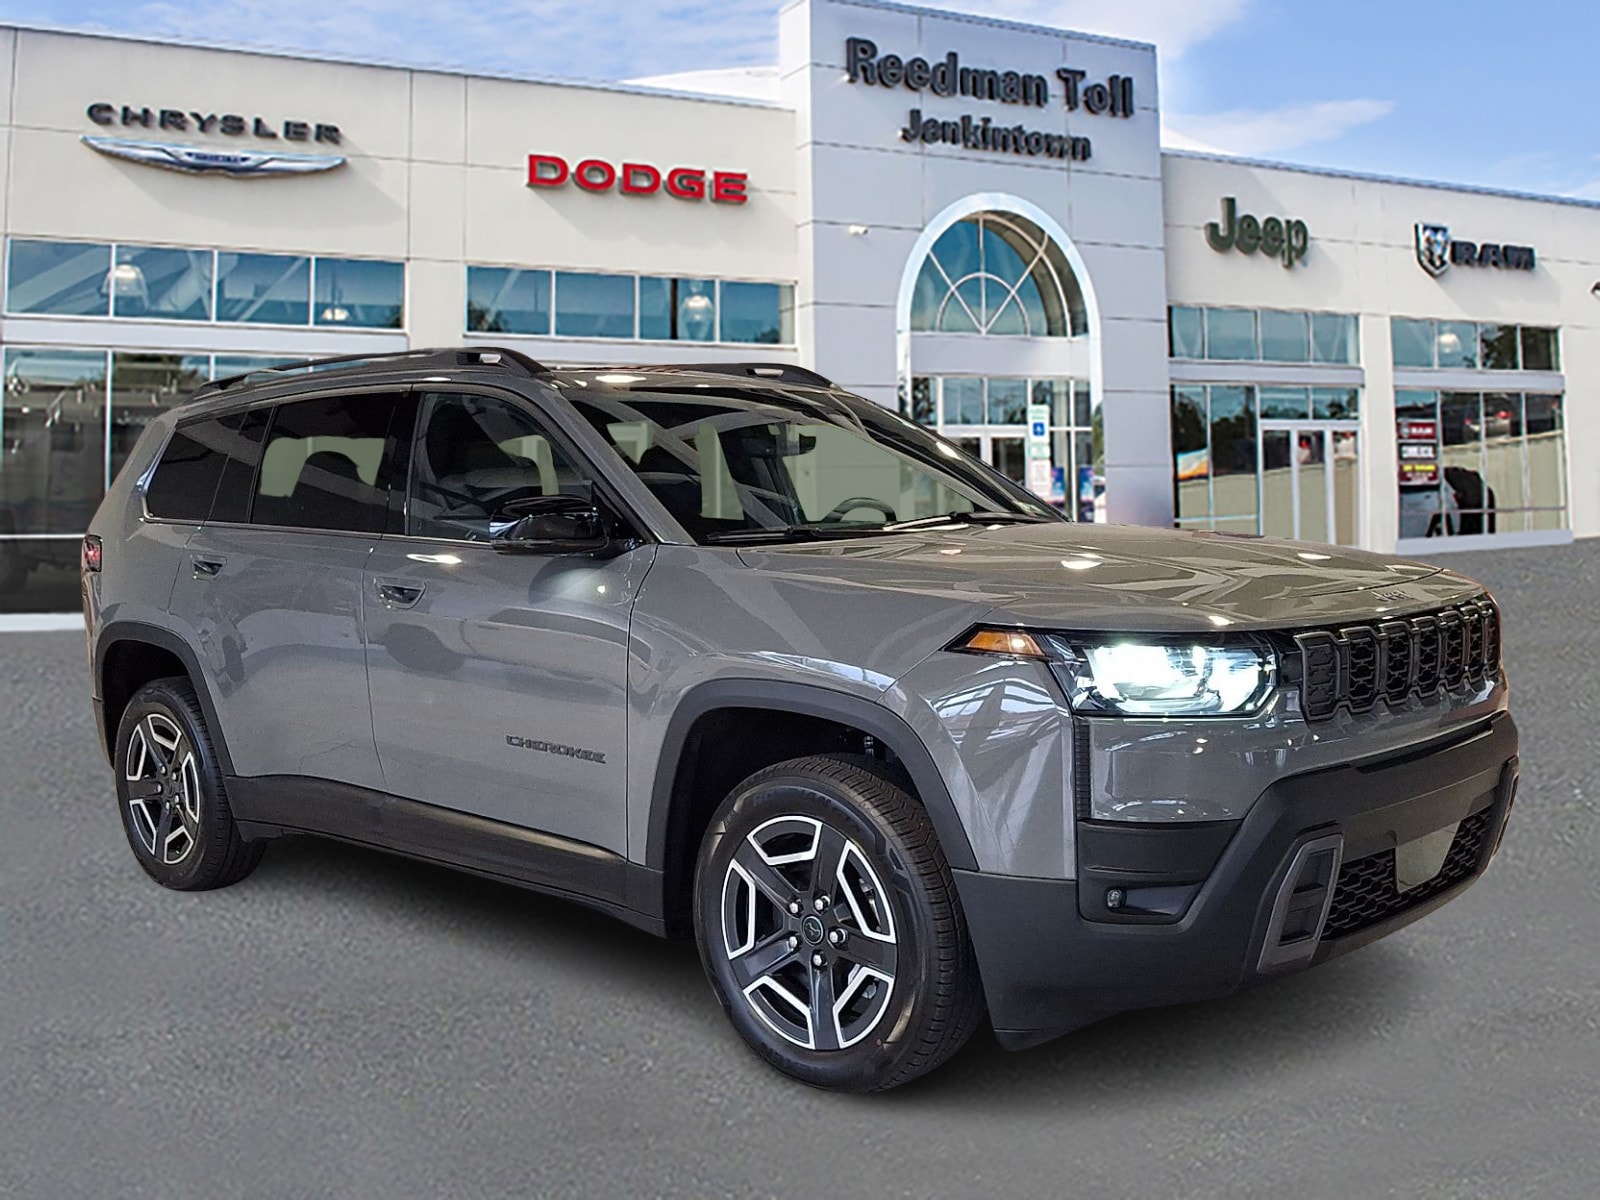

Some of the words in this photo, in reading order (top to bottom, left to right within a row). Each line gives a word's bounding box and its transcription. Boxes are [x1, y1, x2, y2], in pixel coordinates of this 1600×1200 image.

[846, 37, 1048, 107] Reedman
[1056, 67, 1134, 118] Toll
[87, 102, 341, 144] CHRYSLER
[901, 109, 1091, 161] Jenkintown
[527, 154, 748, 205] DODGE
[1204, 197, 1309, 269] Jeep
[1450, 240, 1536, 270] RAM
[506, 735, 606, 764] CHEROKEE
